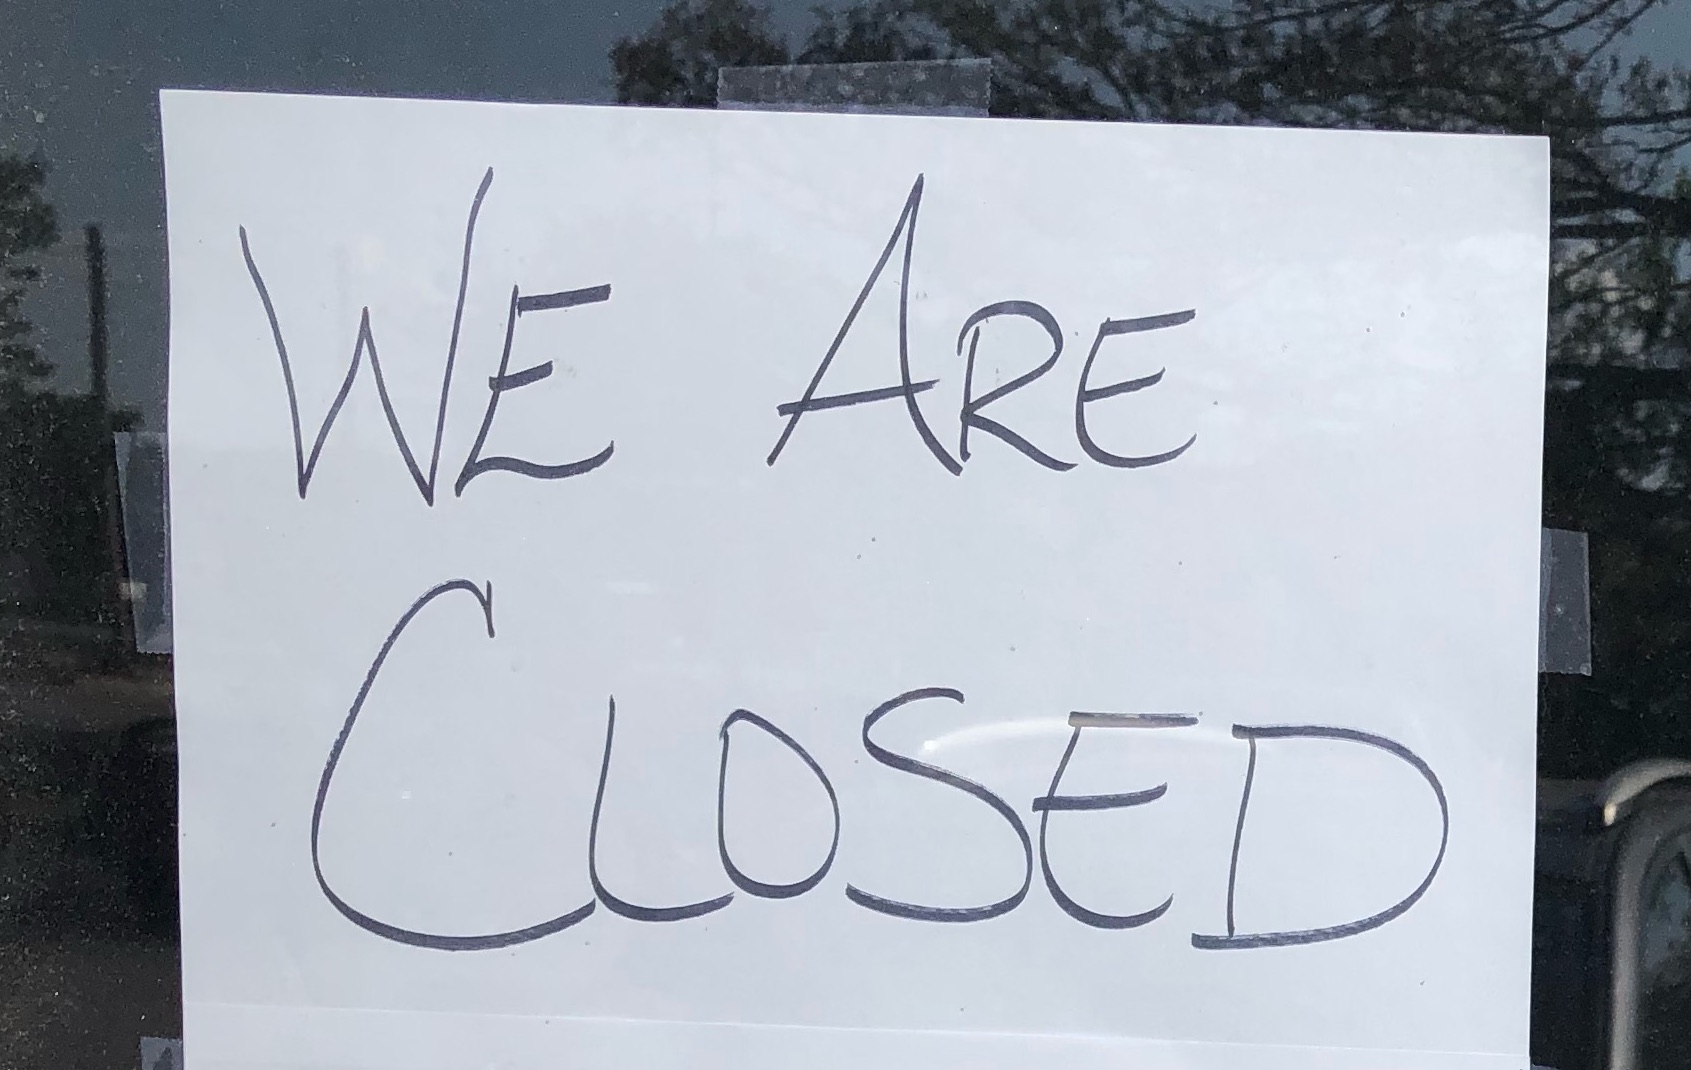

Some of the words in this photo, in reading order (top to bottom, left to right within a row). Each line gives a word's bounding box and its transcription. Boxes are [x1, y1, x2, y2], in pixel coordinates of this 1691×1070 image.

[239, 167, 614, 507] WE
[767, 173, 1197, 476] ARE
[311, 579, 1449, 952] CLOSED
